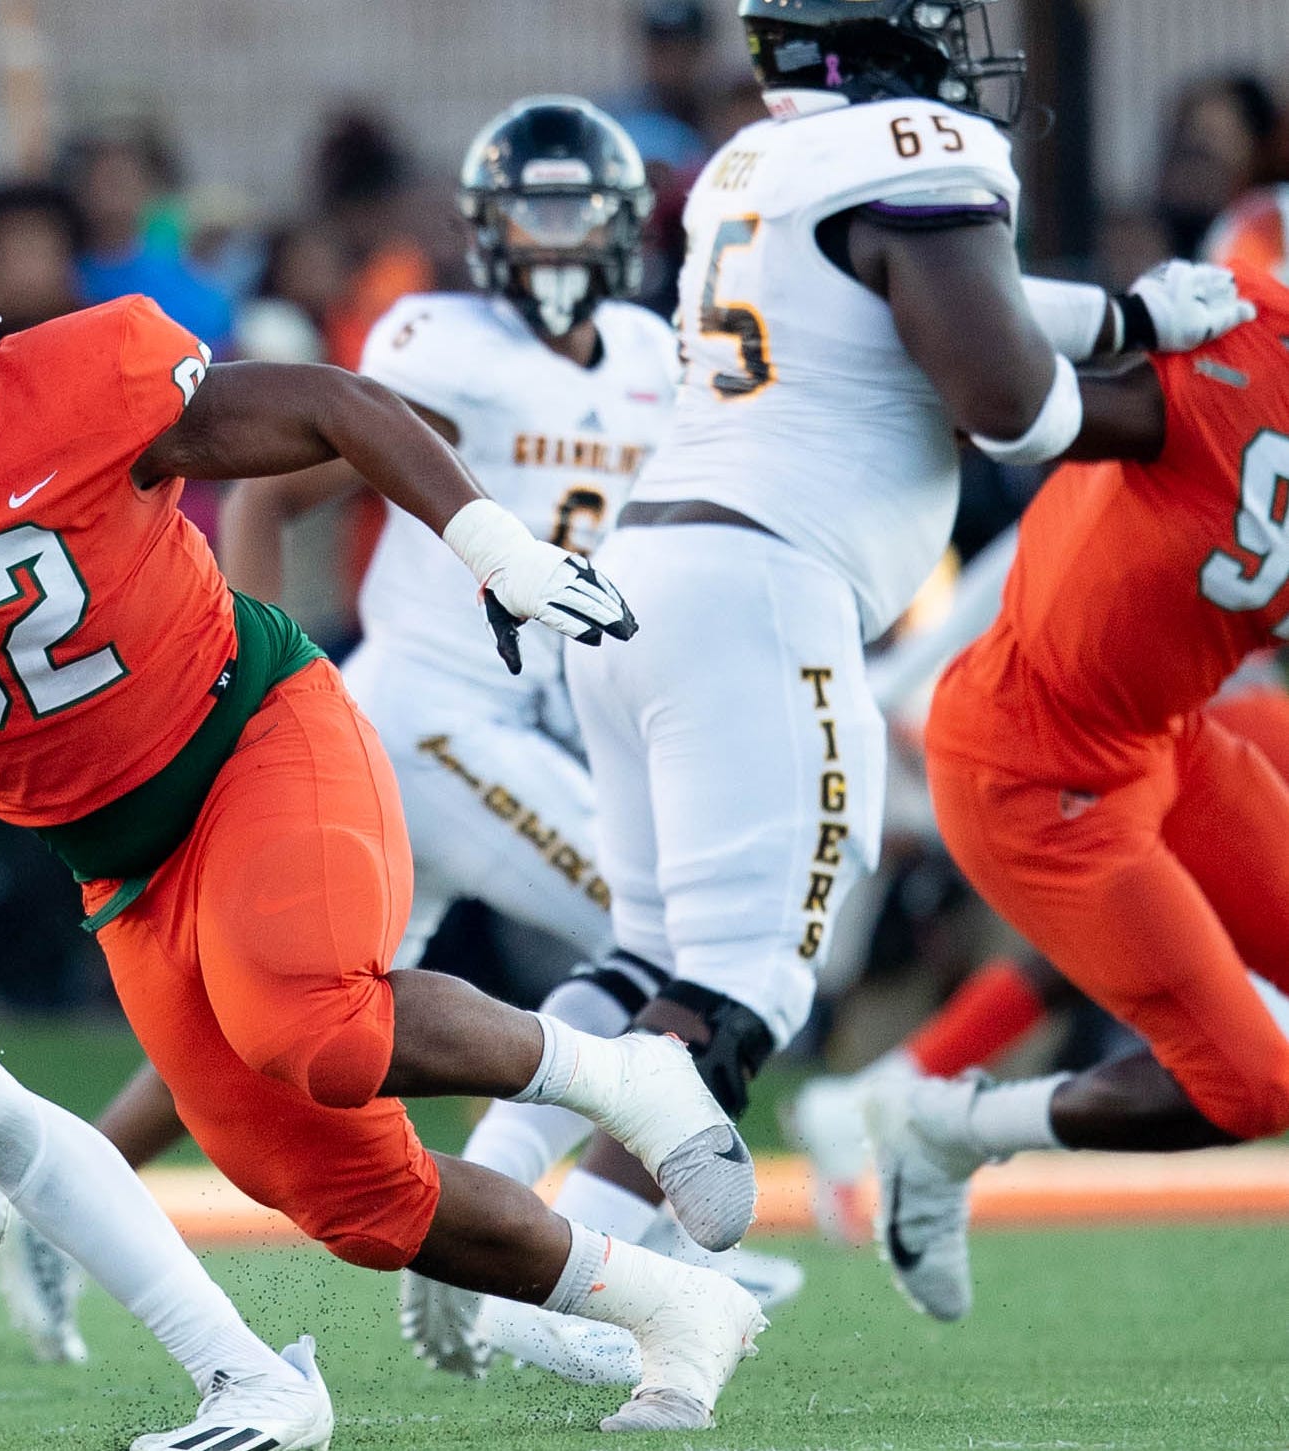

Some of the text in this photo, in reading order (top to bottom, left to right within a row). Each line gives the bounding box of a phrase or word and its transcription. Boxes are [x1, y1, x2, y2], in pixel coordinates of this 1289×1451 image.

[889, 114, 963, 159] 65
[682, 210, 778, 402] 5
[1198, 424, 1289, 640] 9
[799, 667, 847, 959] TIGERS
